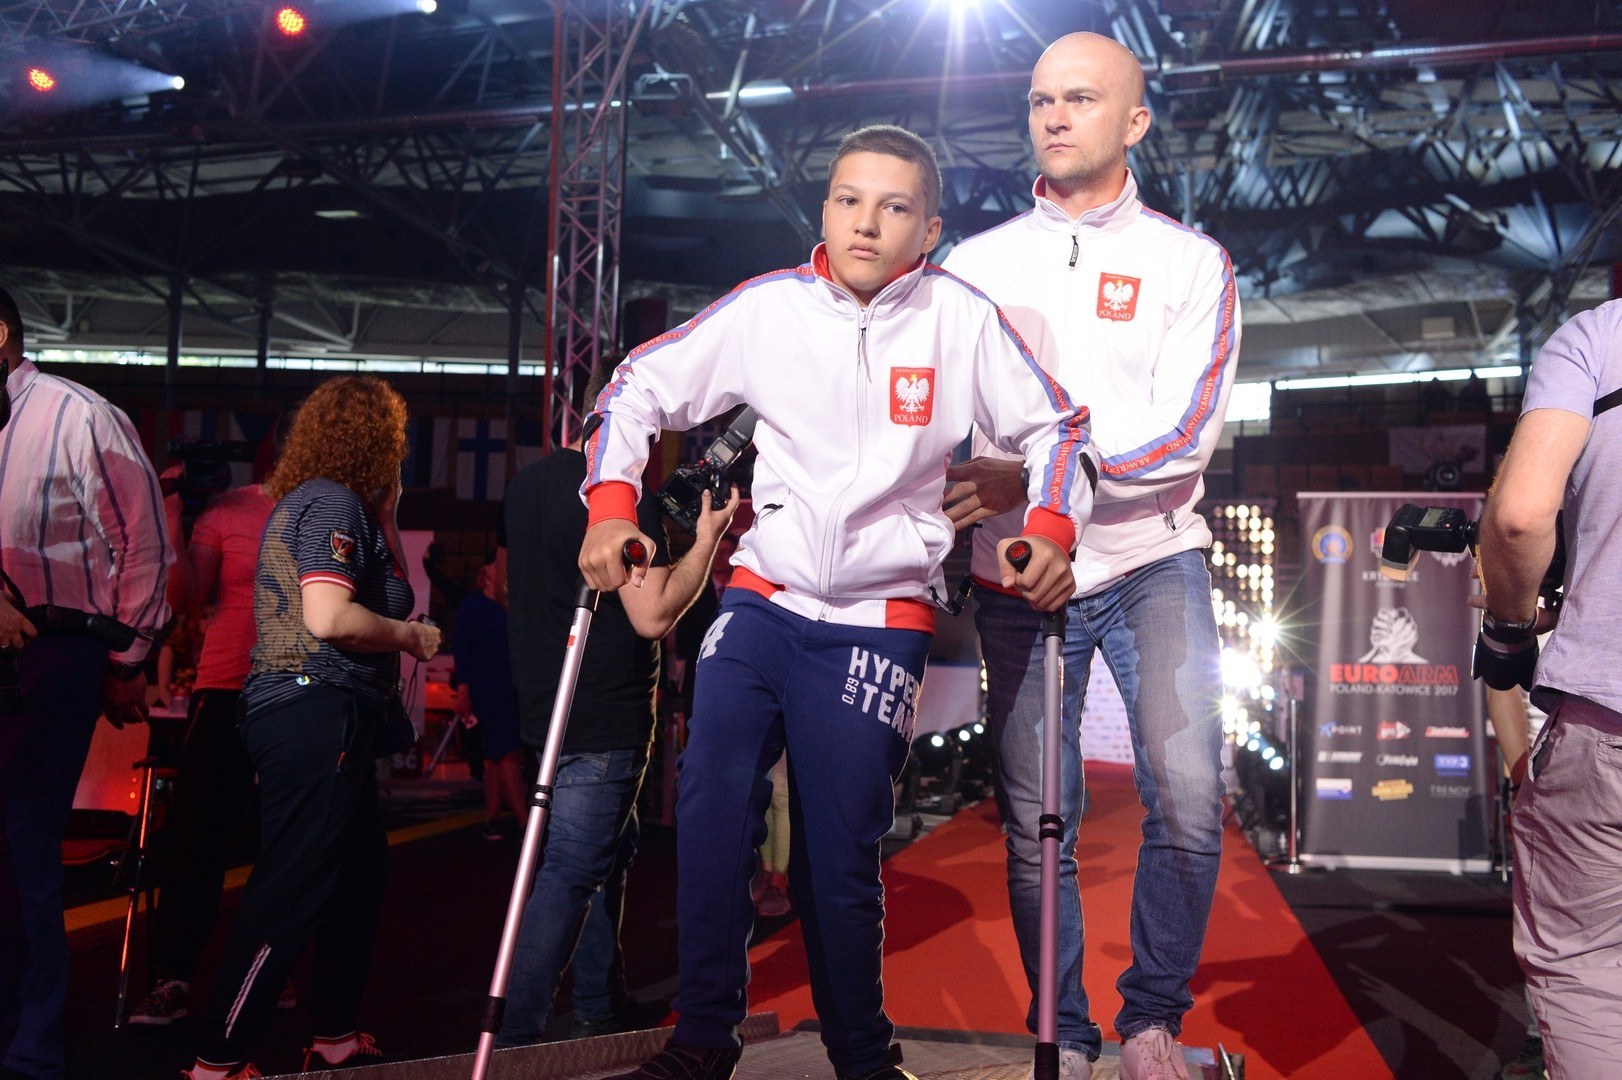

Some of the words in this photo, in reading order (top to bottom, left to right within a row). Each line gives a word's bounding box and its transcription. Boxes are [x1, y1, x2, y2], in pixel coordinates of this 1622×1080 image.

[1099, 309, 1132, 320] POLAND
[894, 413, 929, 423] POLAND
[841, 677, 859, 705] 0.89
[861, 682, 916, 743] TEAM
